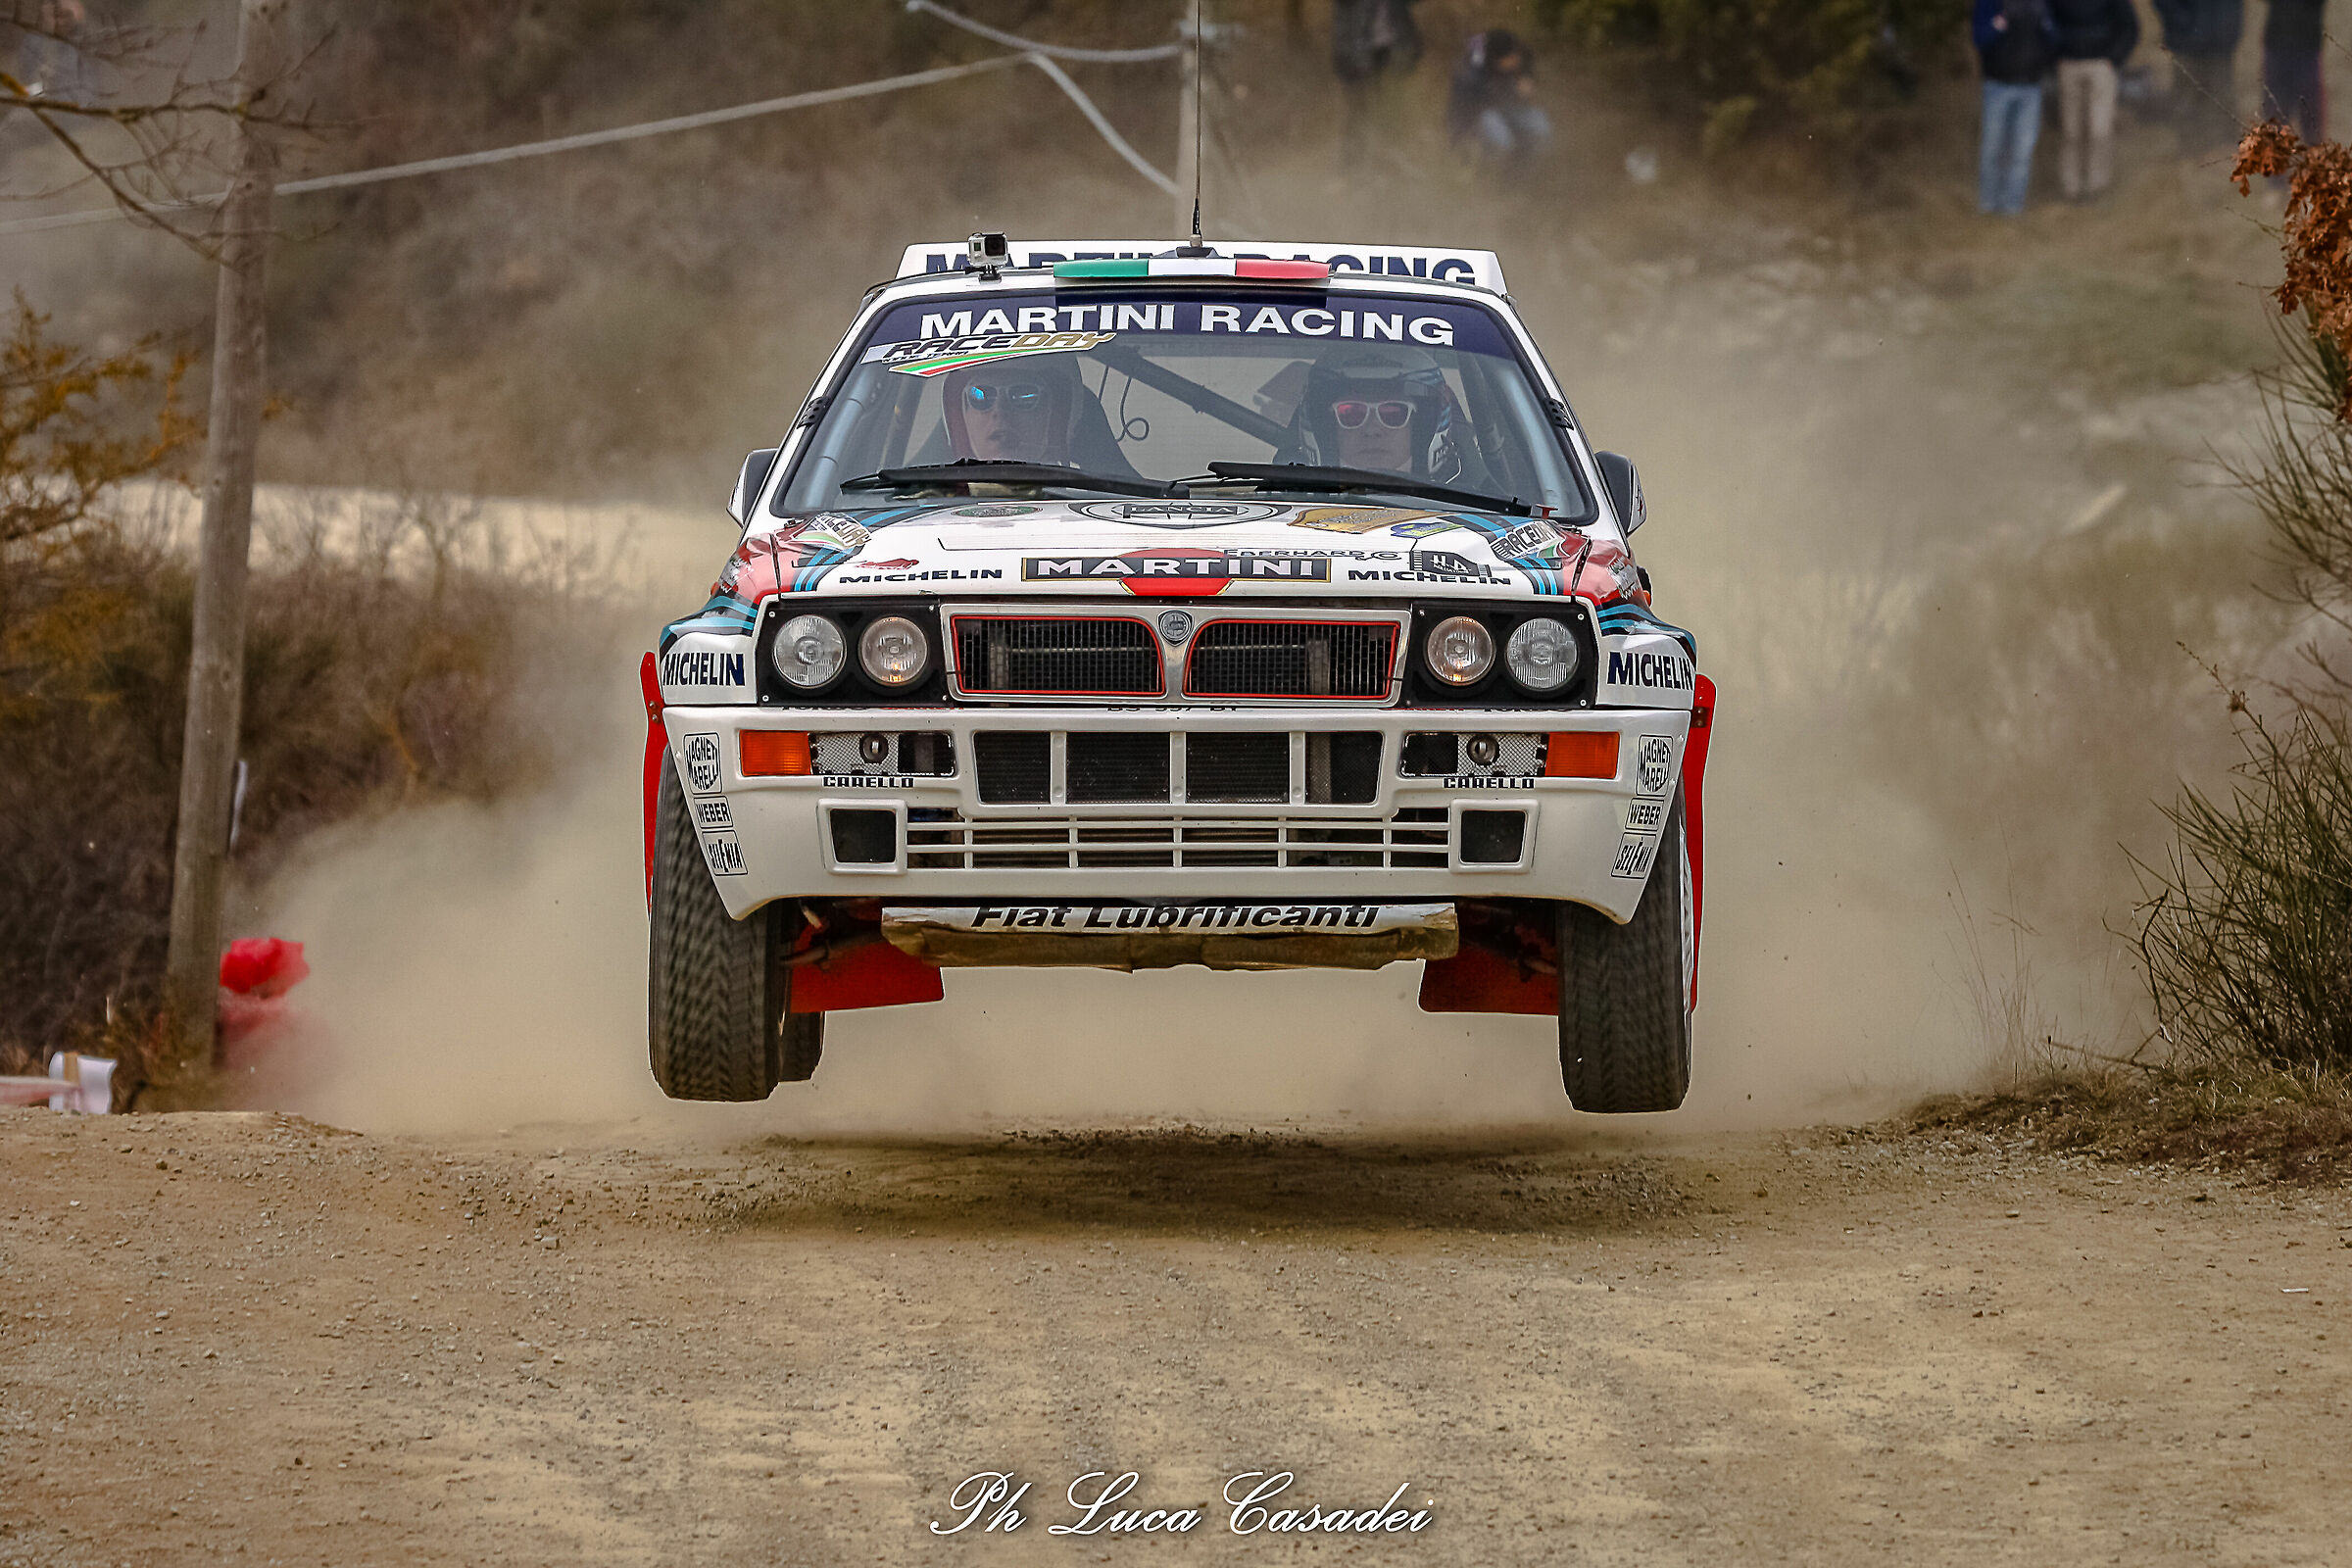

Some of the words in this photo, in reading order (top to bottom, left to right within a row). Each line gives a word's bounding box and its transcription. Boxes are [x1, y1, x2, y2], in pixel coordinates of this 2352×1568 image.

[919, 305, 1176, 341] MARTINI
[1199, 304, 1455, 347] RACING
[882, 331, 1117, 363] RACEDAY
[840, 568, 1003, 584] MICHELIN
[1036, 557, 1314, 577] MARTINI
[1348, 569, 1511, 586] MICHELIN
[662, 652, 746, 687] MICHELIN
[1606, 651, 1694, 691] MICHELIN
[696, 803, 731, 823] WEBER
[1629, 804, 1661, 825] WEBER
[971, 906, 1074, 929] Fiat
[1083, 906, 1381, 930] Lubrificanti
